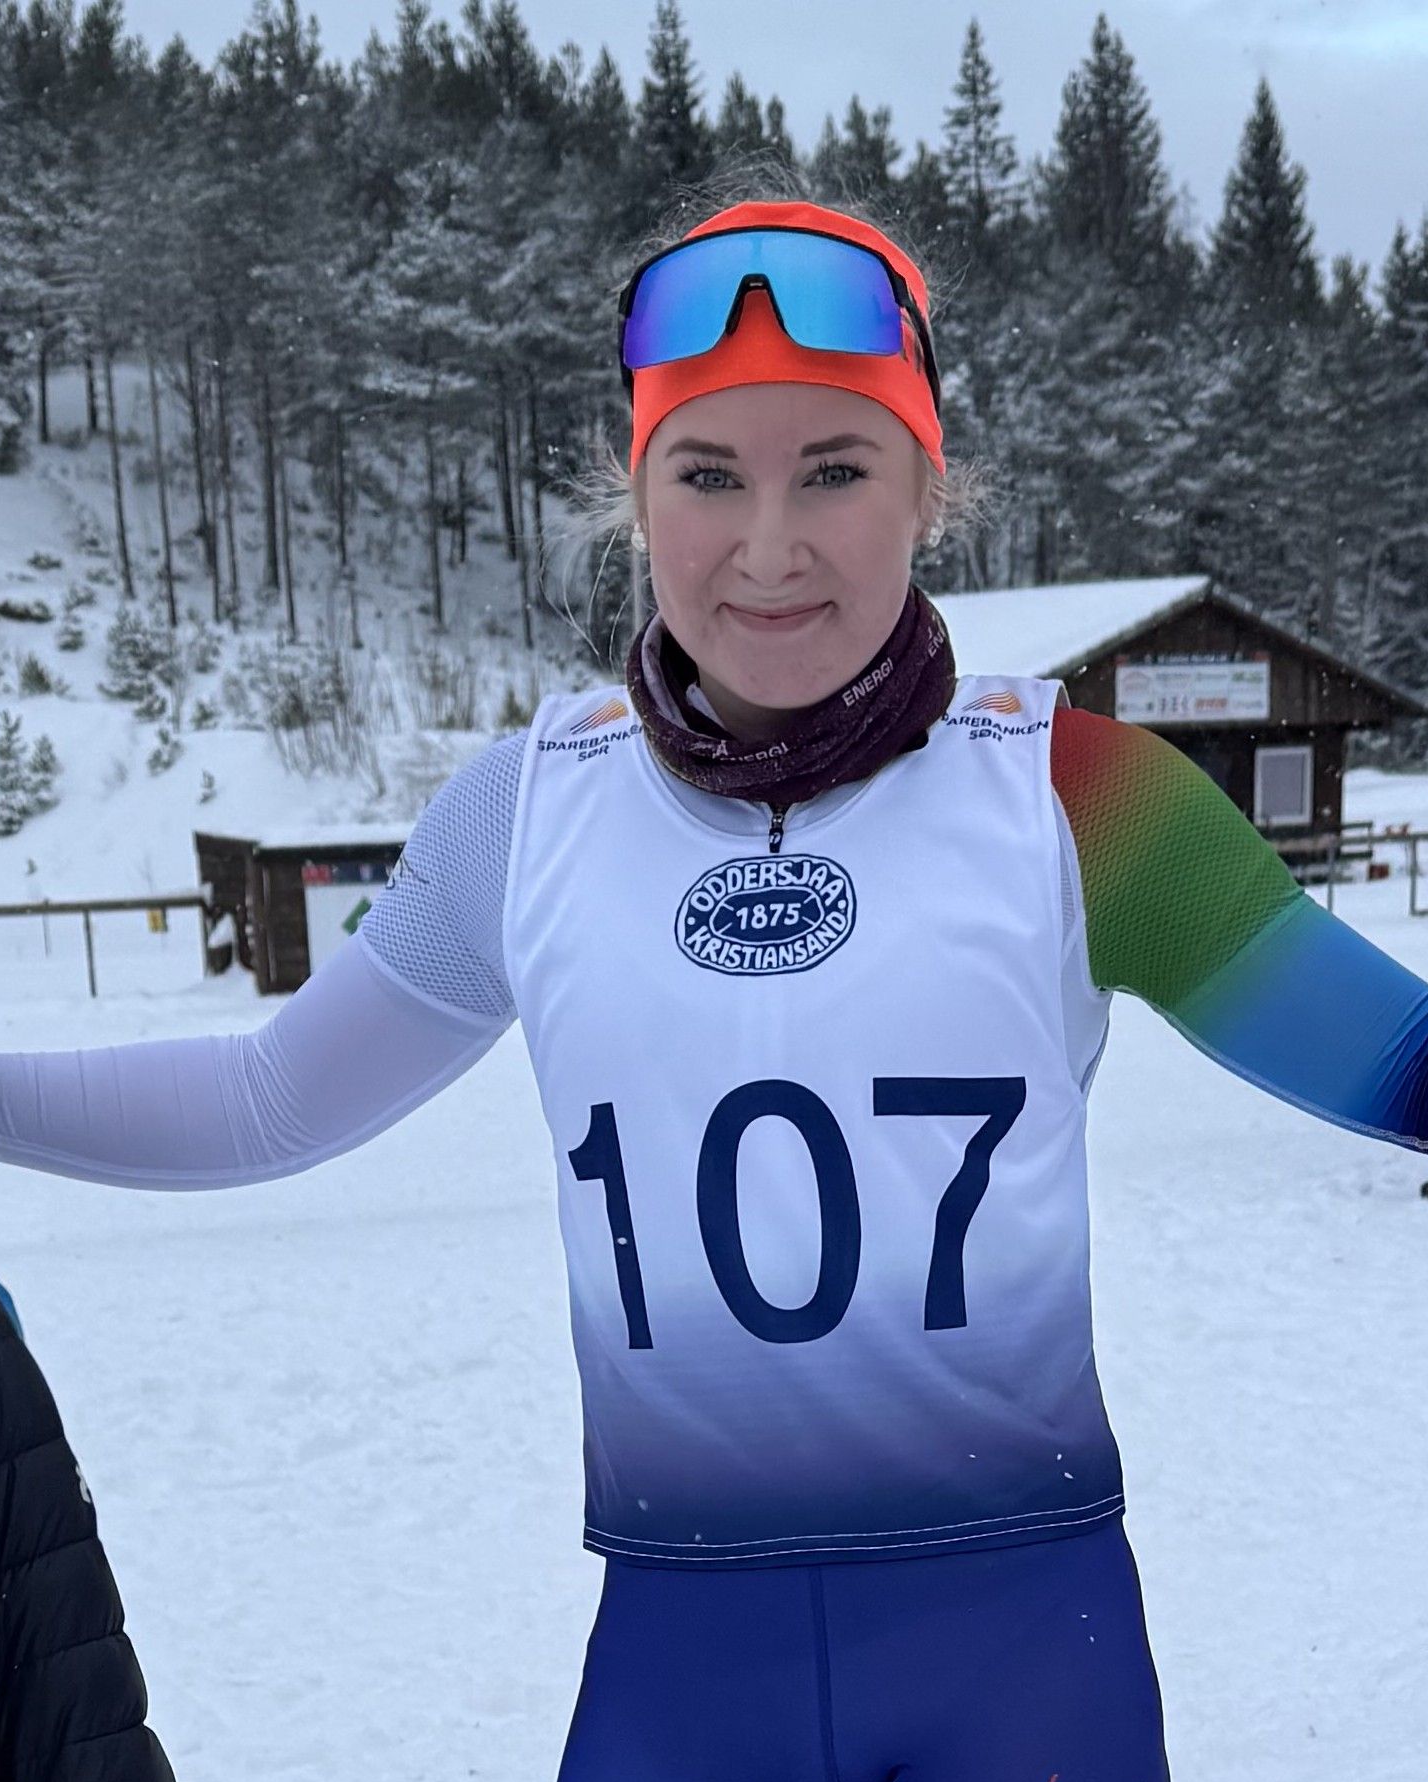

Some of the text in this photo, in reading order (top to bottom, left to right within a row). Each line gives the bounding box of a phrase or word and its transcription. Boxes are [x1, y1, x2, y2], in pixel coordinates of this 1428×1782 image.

[841, 656, 895, 708] ENERGI
[942, 712, 1049, 736] PAREBANKEN
[690, 860, 845, 912] ODDERSJAA
[685, 910, 847, 970] KRISTIANSAND
[735, 902, 802, 931] 1875
[567, 1076, 1027, 1350] 107
